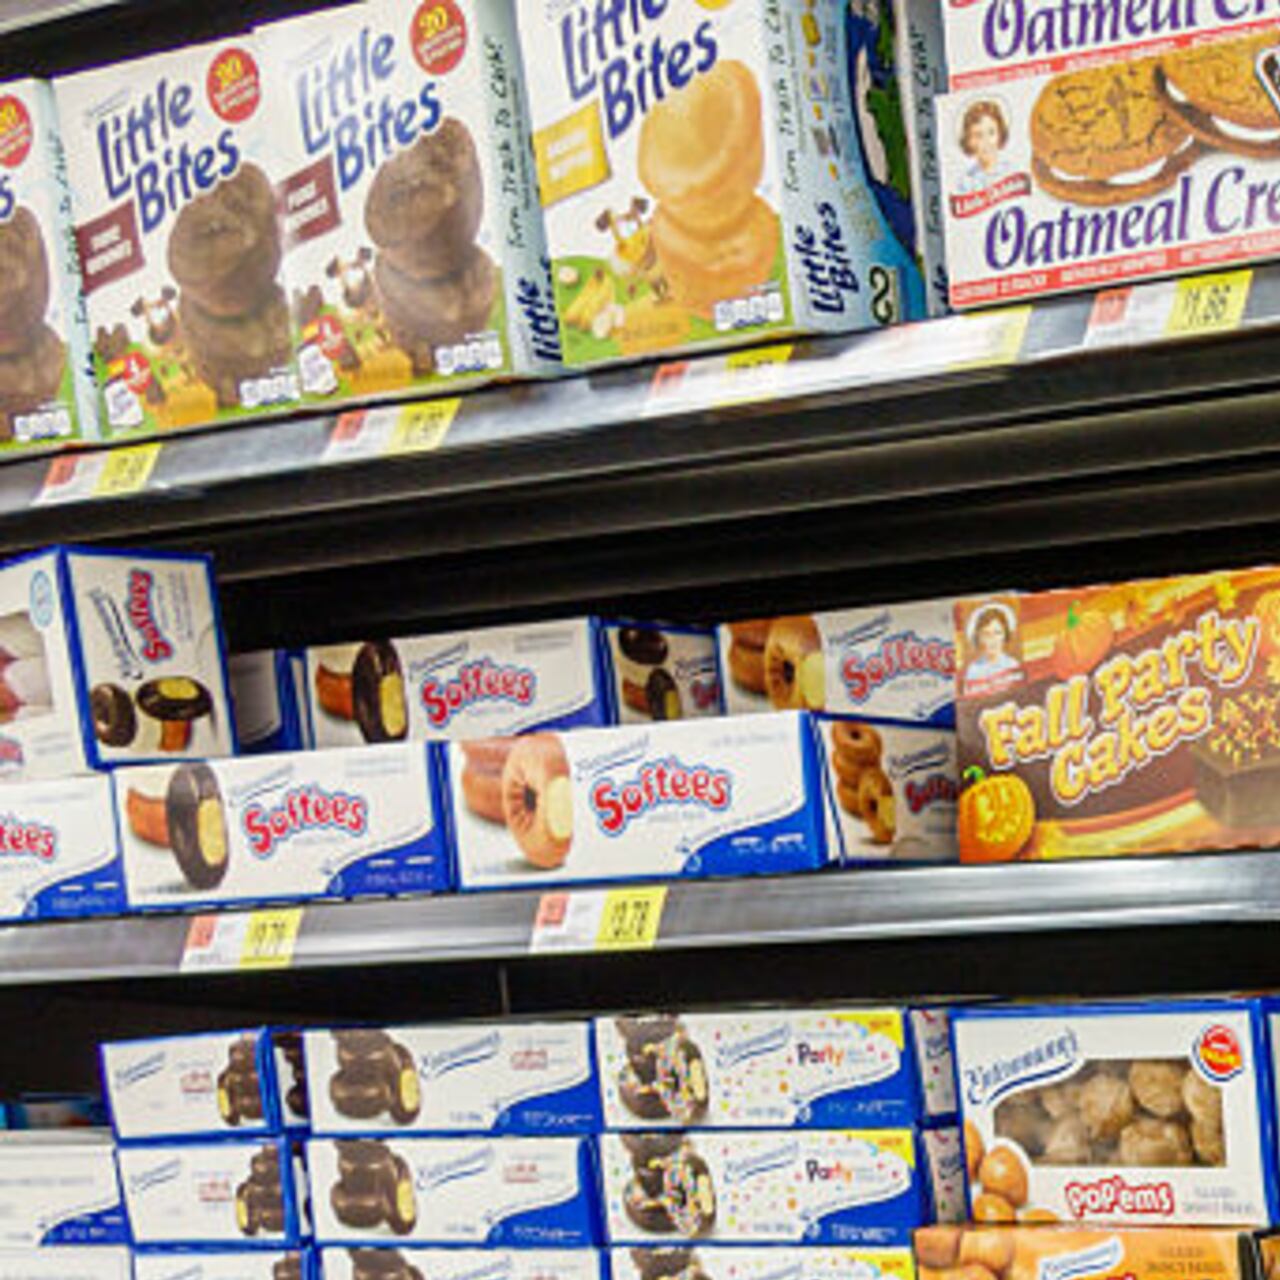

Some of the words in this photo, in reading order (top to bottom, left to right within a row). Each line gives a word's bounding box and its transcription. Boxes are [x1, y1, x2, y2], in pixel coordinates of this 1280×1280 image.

[299, 27, 396, 155] Little
[602, 21, 719, 140] Bites
[97, 78, 193, 200] Little
[135, 130, 240, 234] Bites
[334, 82, 442, 192] Bites
[794, 224, 848, 314] Little
[818, 200, 860, 294] Bites
[985, 178, 1191, 272] Oatmeal
[126, 570, 170, 663] Softees
[422, 660, 536, 727] Softees
[842, 646, 957, 706] Softees
[981, 690, 1092, 768] Fall
[1097, 612, 1260, 712] Party
[1051, 686, 1213, 806] Cakes
[243, 789, 366, 859] Softees
[590, 768, 731, 835] Softees
[797, 1042, 846, 1069] Party
[805, 1159, 854, 1184] Party
